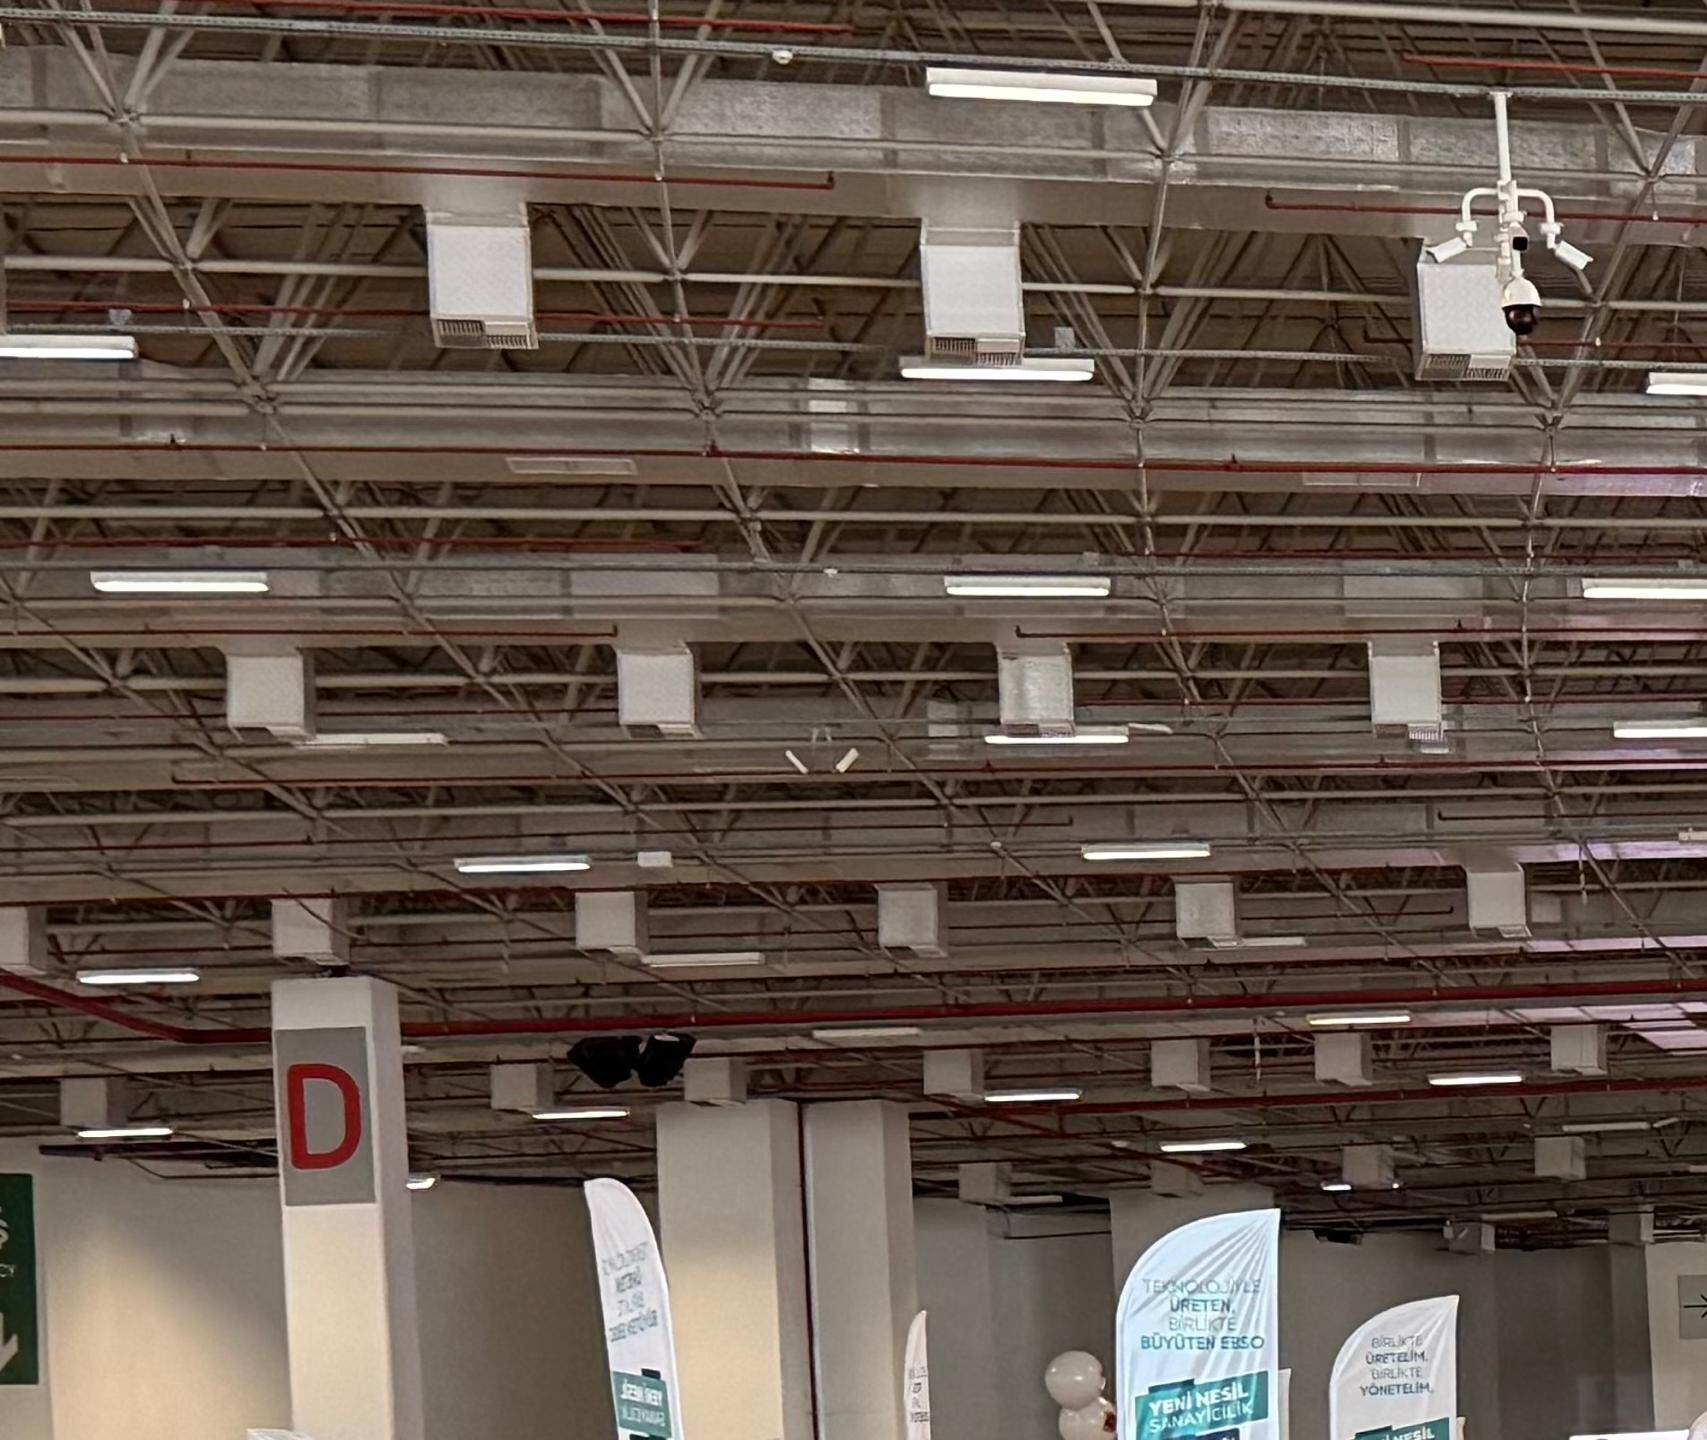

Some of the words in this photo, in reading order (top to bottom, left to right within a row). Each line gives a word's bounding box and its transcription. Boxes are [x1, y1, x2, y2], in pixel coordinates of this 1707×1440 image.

[286, 1063, 362, 1170] D
[1141, 1332, 1215, 1350] BÜYÜTEN
[1220, 1335, 1265, 1350] EBSO
[1149, 1390, 1193, 1416] YENİ
[1194, 1381, 1249, 1407] NESİL
